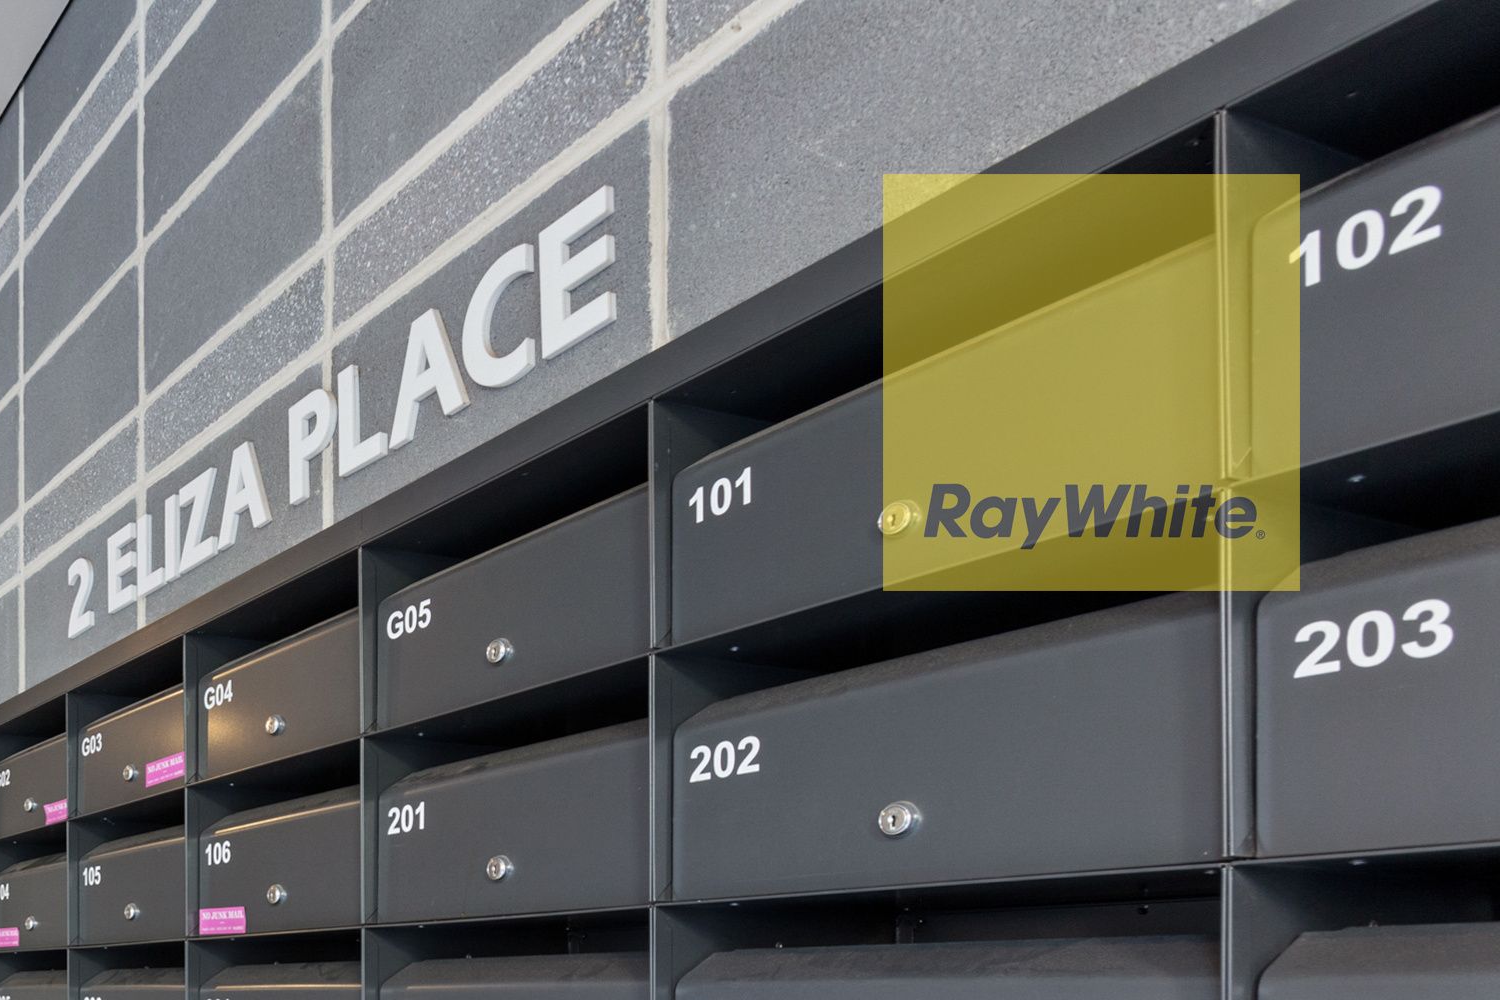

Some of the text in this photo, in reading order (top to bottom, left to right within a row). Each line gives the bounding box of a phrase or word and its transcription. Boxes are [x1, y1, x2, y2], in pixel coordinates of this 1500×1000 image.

[1288, 185, 1443, 287] 102
[68, 185, 618, 639] 2 ELIZA PLACE
[688, 466, 752, 524] 101
[386, 598, 432, 640] G05
[1292, 598, 1454, 679] 203
[204, 680, 233, 710] G04
[81, 732, 103, 757] G03
[689, 735, 761, 783] 202
[387, 801, 426, 836] 201
[205, 840, 231, 866] 106
[82, 866, 102, 886] 105
